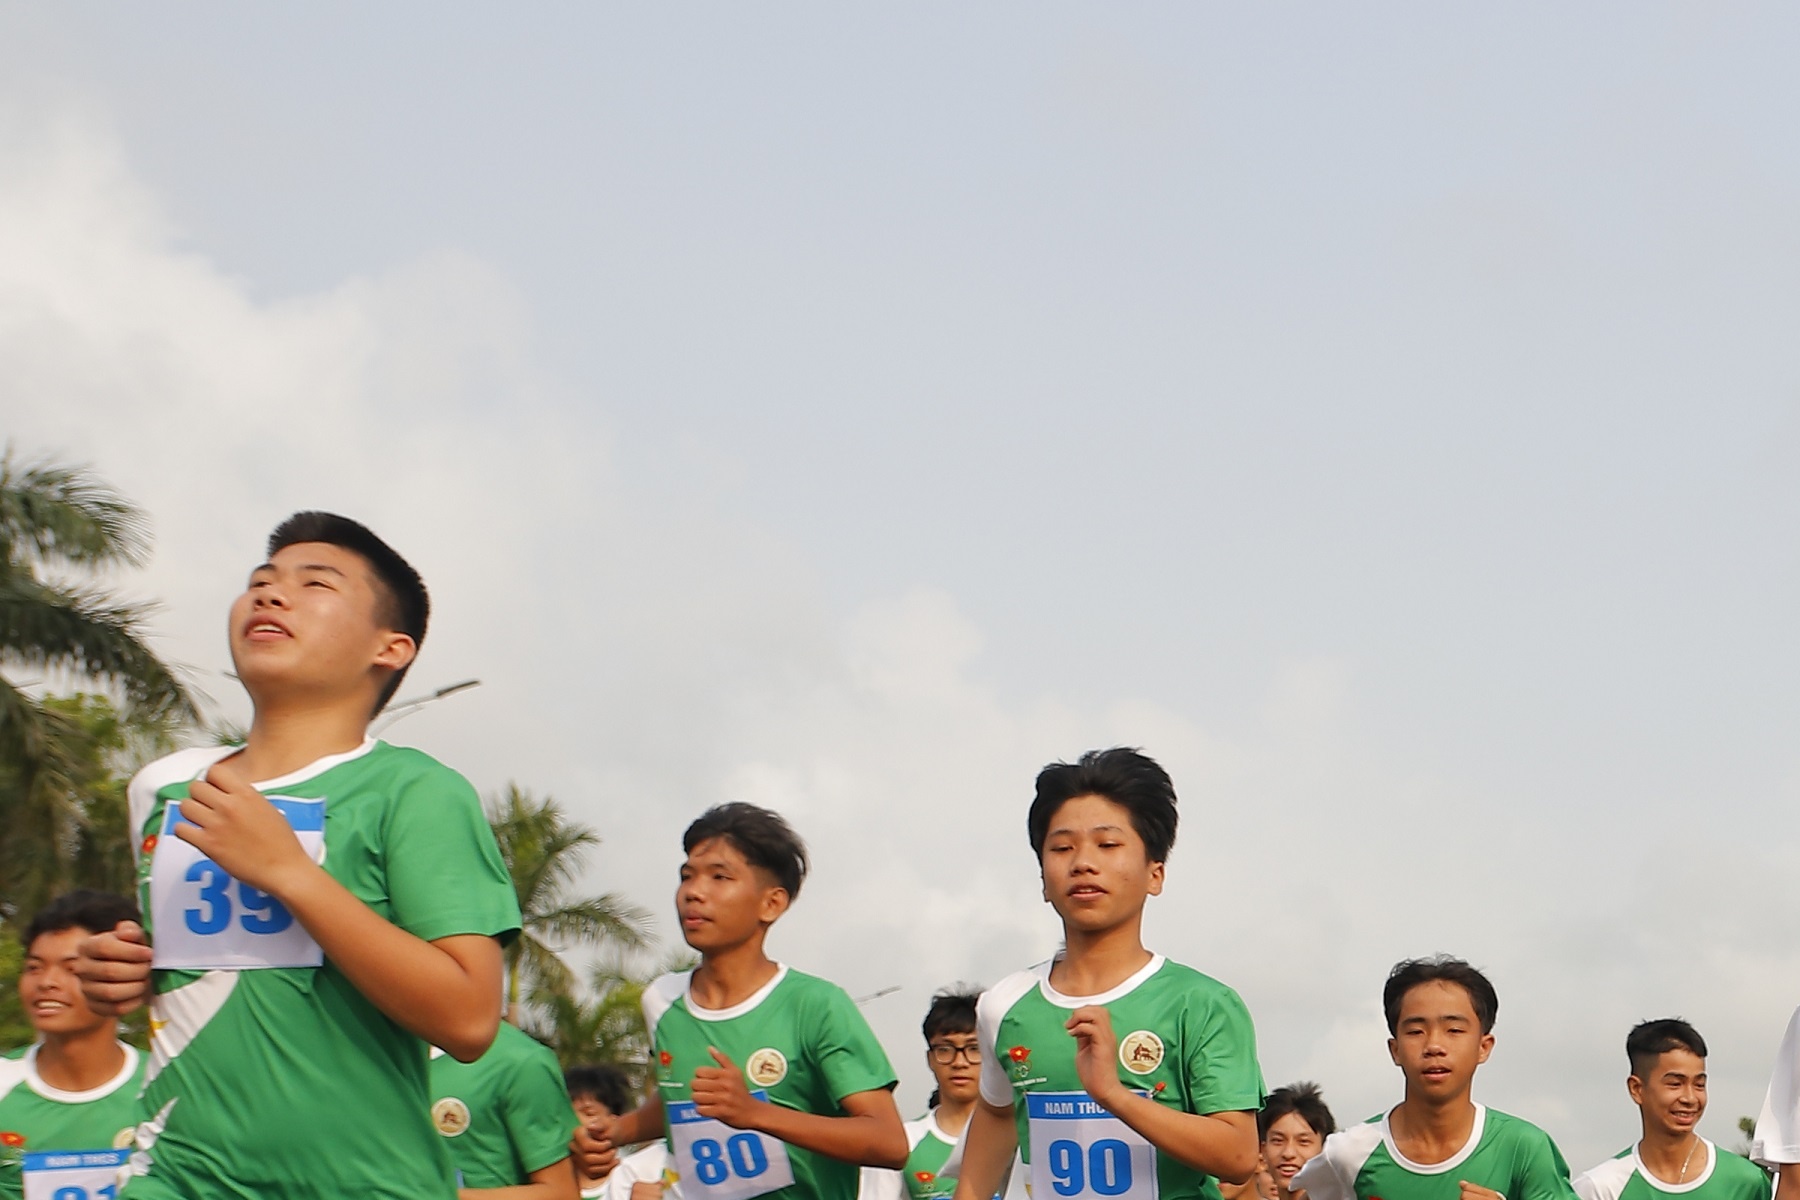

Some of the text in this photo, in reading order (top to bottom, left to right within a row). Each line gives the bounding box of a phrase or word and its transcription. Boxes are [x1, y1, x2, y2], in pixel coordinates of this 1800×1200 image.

[184, 859, 294, 935] 39
[1045, 1102, 1073, 1115] NAM
[692, 1132, 769, 1185] 80
[1050, 1139, 1133, 1197] 90
